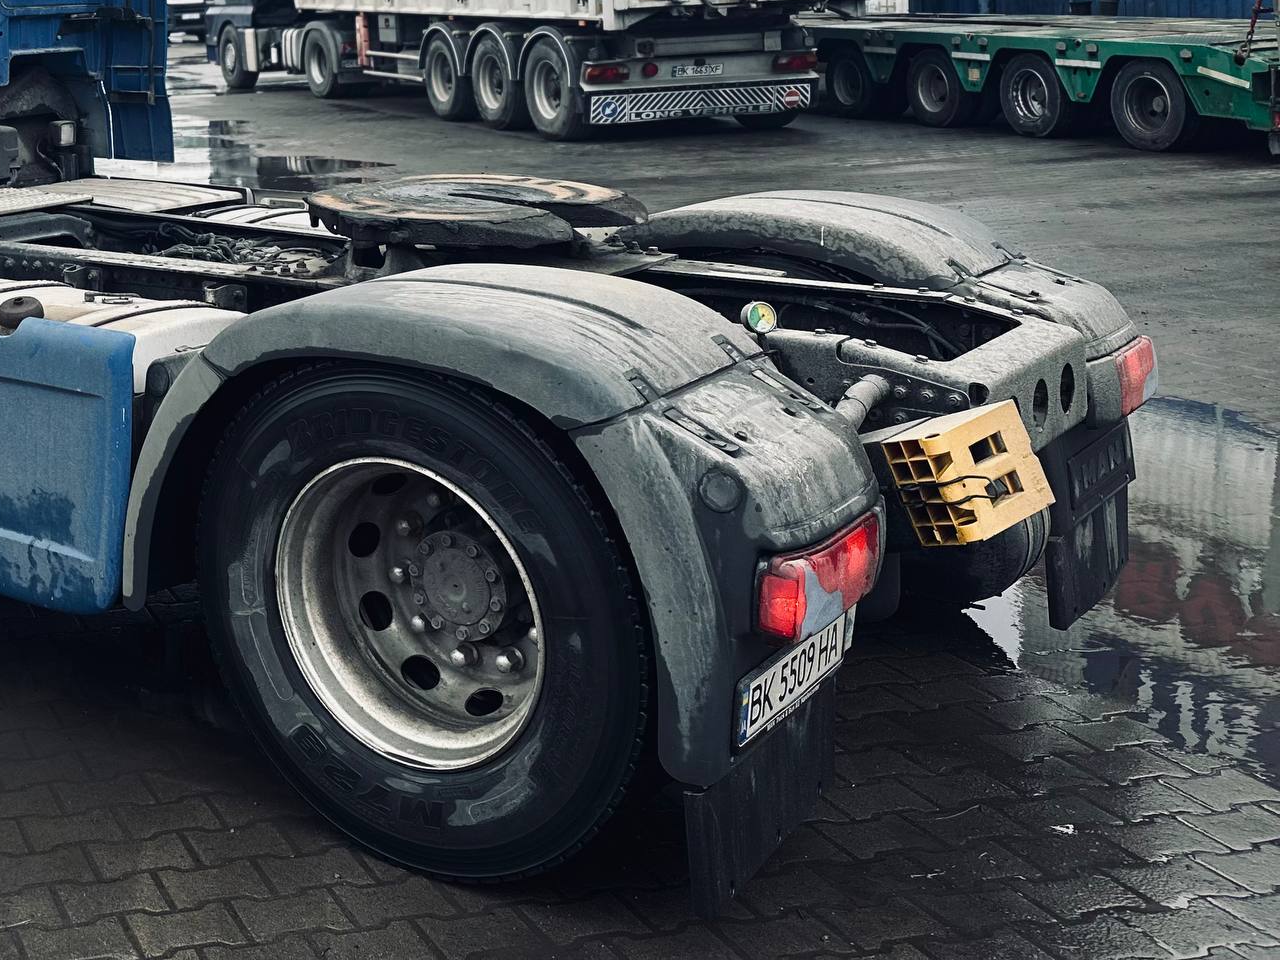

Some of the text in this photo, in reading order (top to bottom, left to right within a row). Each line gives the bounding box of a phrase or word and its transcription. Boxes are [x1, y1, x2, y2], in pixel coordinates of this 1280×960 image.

[629, 104, 771, 121] LONG VEHICLE
[286, 406, 547, 537] BRIDGESTONE
[748, 622, 838, 729] BK 5509 HA
